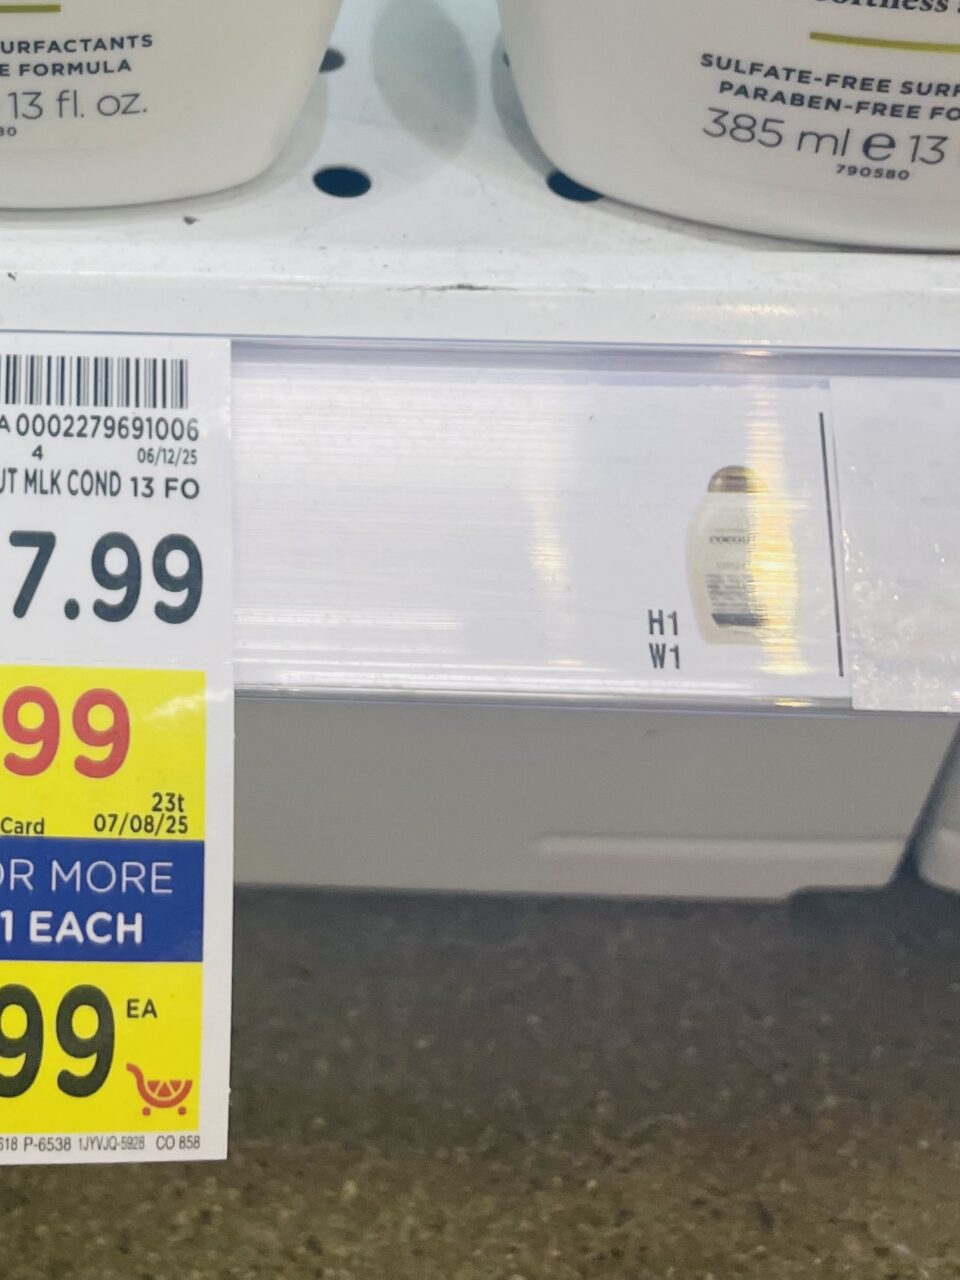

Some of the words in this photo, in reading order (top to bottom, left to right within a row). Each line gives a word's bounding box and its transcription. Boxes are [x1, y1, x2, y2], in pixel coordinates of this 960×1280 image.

[19, 58, 132, 76] FORMULA
[701, 52, 892, 93] SULFATE-FREE
[8, 91, 43, 120] 13
[56, 89, 85, 118] fl.
[97, 91, 148, 116] oz.
[718, 81, 922, 120] PARABEN-FREE
[703, 107, 785, 148] 385
[796, 127, 850, 157] ml
[909, 134, 949, 165] 13
[836, 164, 910, 181] 790580
[31, 445, 44, 461] 4
[136, 446, 198, 466] 06/12/25
[24, 468, 61, 495] MLK
[67, 469, 122, 498] COND
[130, 476, 155, 498] 13
[165, 477, 200, 500] FO
[9, 530, 204, 624] 7.99
[648, 609, 679, 636] H1
[648, 643, 681, 670] W1
[152, 792, 185, 813] 23t
[0, 816, 45, 835] Card
[93, 814, 189, 835] 07/08/25
[51, 860, 173, 894] MORE
[29, 911, 143, 944] EACH
[126, 998, 158, 1019] EA
[24, 1136, 72, 1152] P-6538
[156, 1135, 175, 1150] CO
[179, 1135, 201, 1150] 858
